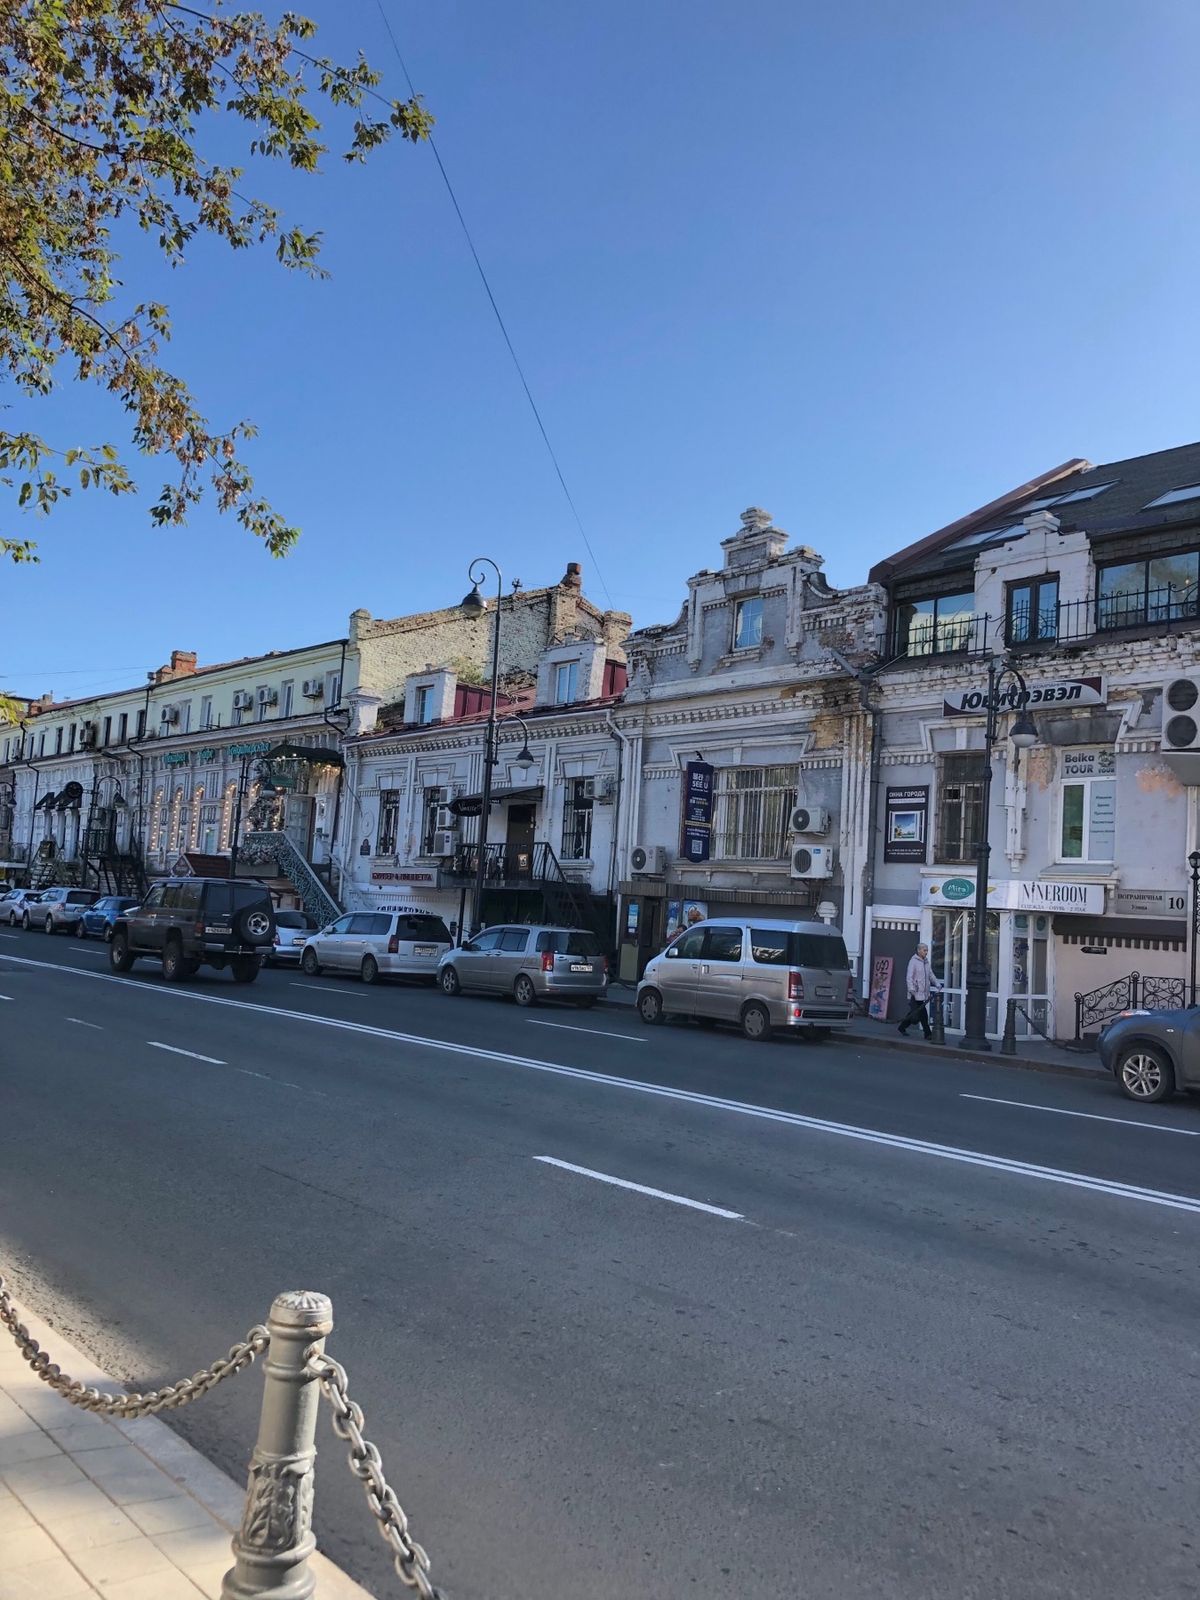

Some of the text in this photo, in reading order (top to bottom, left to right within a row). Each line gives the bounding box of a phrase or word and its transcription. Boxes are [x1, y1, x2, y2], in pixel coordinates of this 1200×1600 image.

[1064, 764, 1094, 774] TOUR
[1117, 893, 1163, 901] ПОГРАНИЧНАЯ
[1168, 897, 1185, 910] 10
